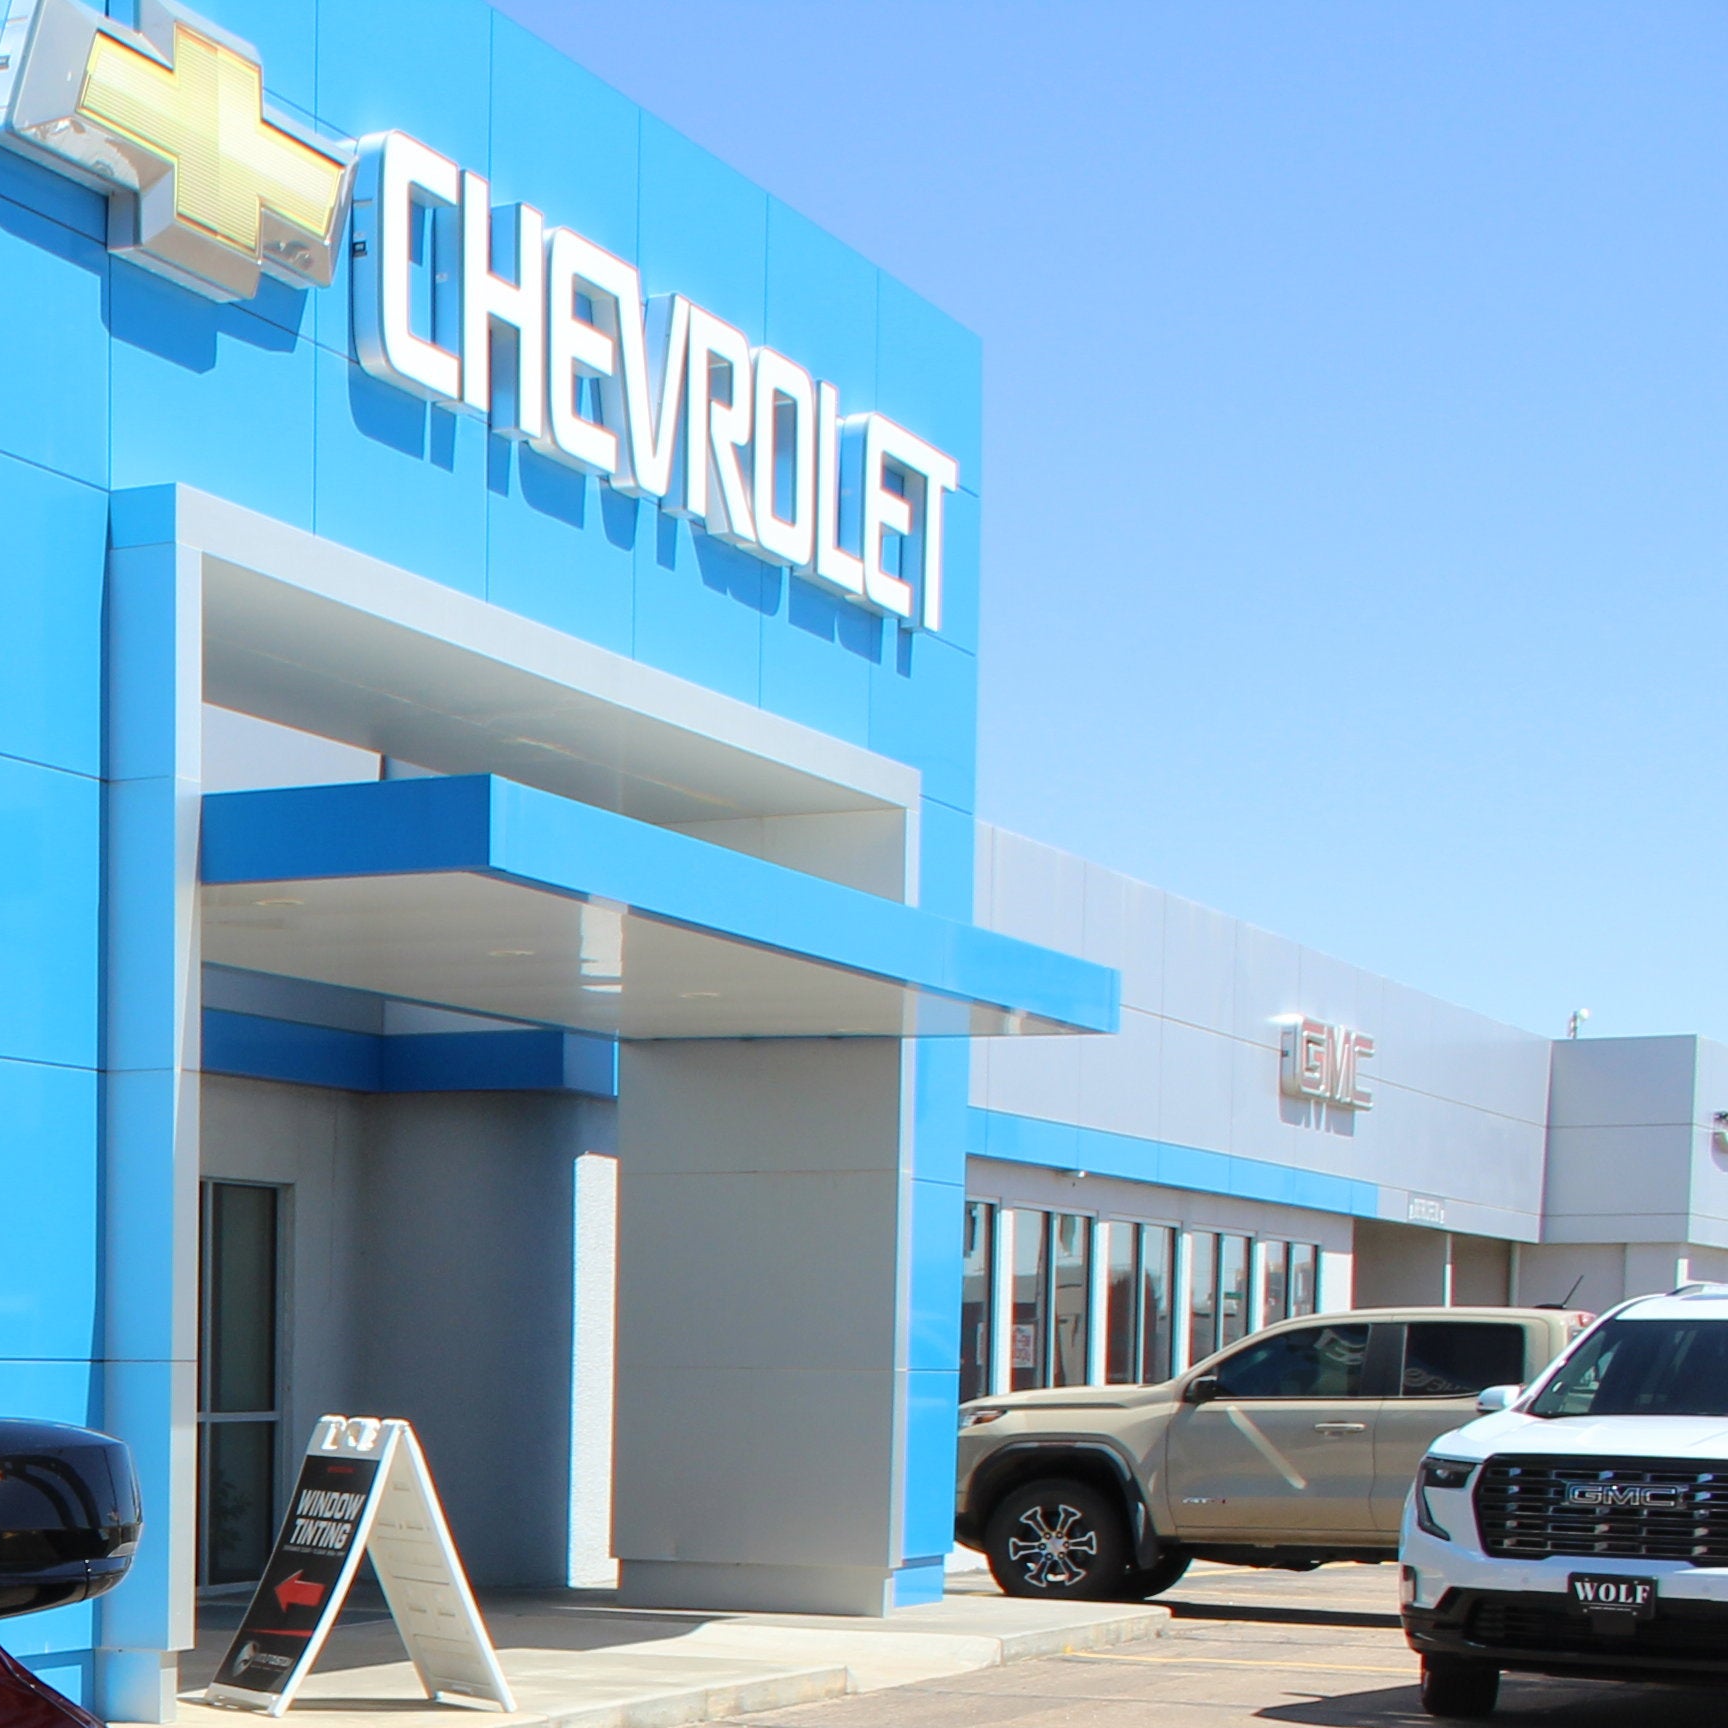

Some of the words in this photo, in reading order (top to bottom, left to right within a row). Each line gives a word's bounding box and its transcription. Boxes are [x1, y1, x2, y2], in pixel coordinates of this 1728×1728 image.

[352, 129, 958, 633] CHEVROLET
[1289, 1016, 1375, 1109] GMC
[296, 1489, 366, 1520] WINDOW
[1567, 1483, 1677, 1507] GMC
[289, 1518, 352, 1550] TINTING
[1574, 1580, 1651, 1604] WOLF
